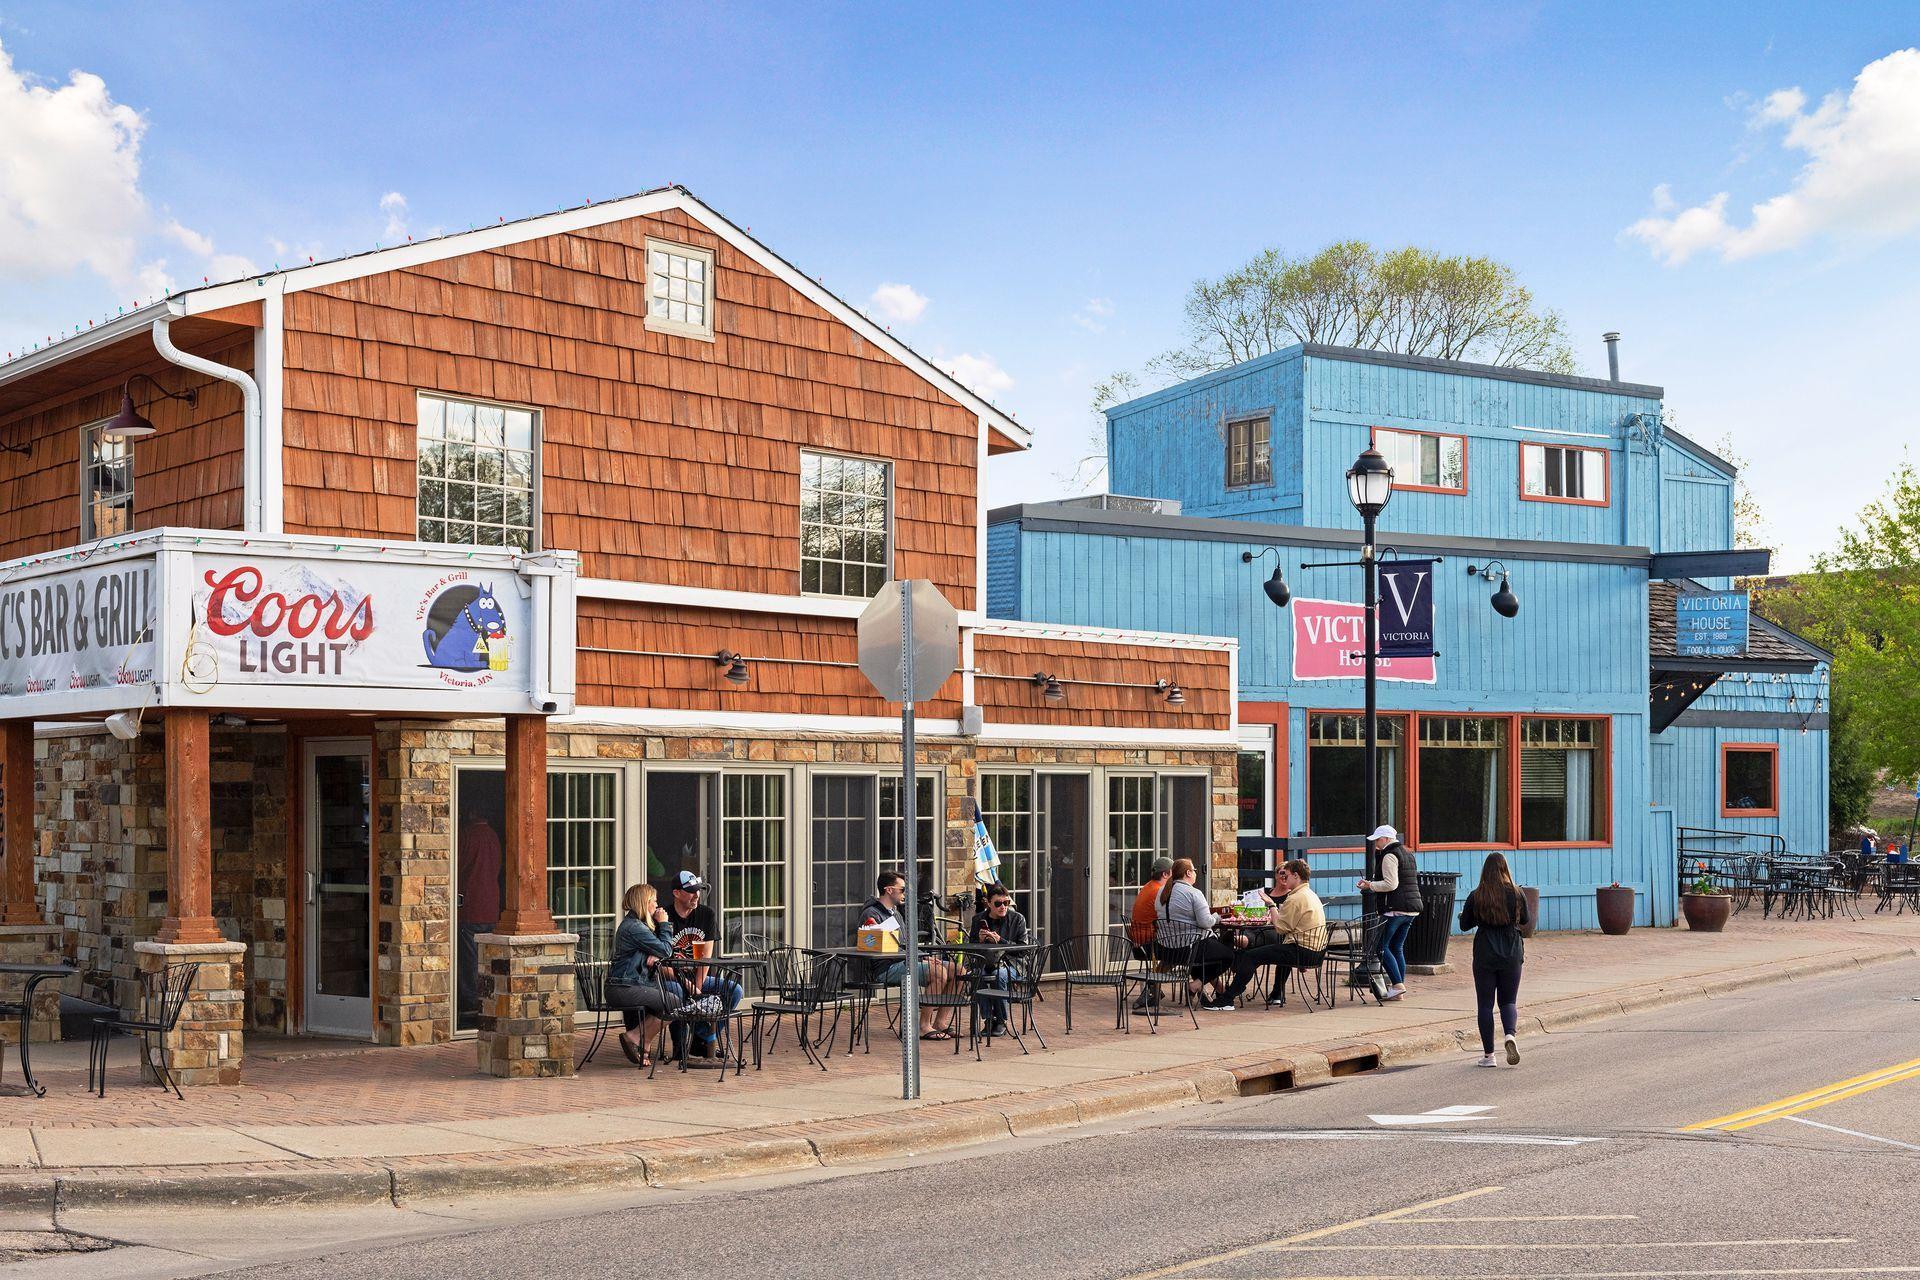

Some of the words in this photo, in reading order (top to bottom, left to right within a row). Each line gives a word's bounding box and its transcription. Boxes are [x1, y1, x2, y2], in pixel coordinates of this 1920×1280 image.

[204, 566, 374, 641] Coors
[416, 599, 428, 620] Vic's
[425, 583, 439, 598] Bar
[440, 578, 447, 586] &
[448, 572, 468, 581] Grill
[1381, 572, 1428, 627] V
[1682, 597, 1741, 611] VICTORIA
[31, 584, 69, 657] BAR
[73, 580, 88, 651] &
[94, 569, 153, 648] GRILL
[1691, 616, 1731, 630] HOUSE
[1382, 632, 1430, 641] VICTORIA
[240, 640, 348, 675] LIGHT
[134, 669, 153, 682] LIGHT
[439, 671, 476, 687] Victoria,
[478, 674, 493, 686] MN
